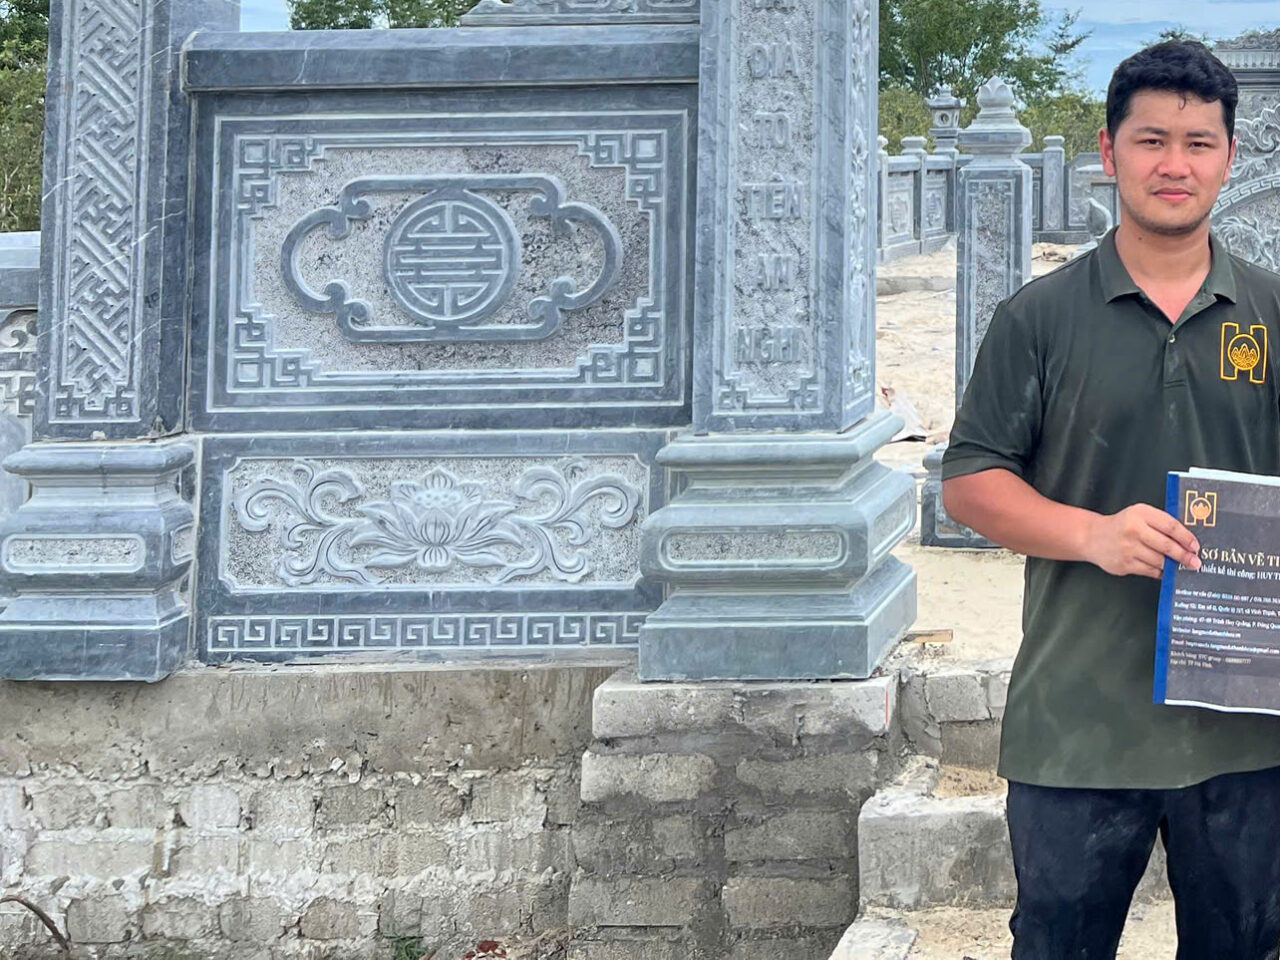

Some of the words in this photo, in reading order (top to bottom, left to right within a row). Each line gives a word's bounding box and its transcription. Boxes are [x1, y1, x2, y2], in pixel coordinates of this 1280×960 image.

[741, 172, 804, 220] TIÊN
[1201, 547, 1219, 560] SƠ
[1221, 548, 1247, 565] BẢN
[1248, 551, 1265, 567] VẼ
[1201, 563, 1217, 573] thiết
[1257, 571, 1274, 581] HUY
